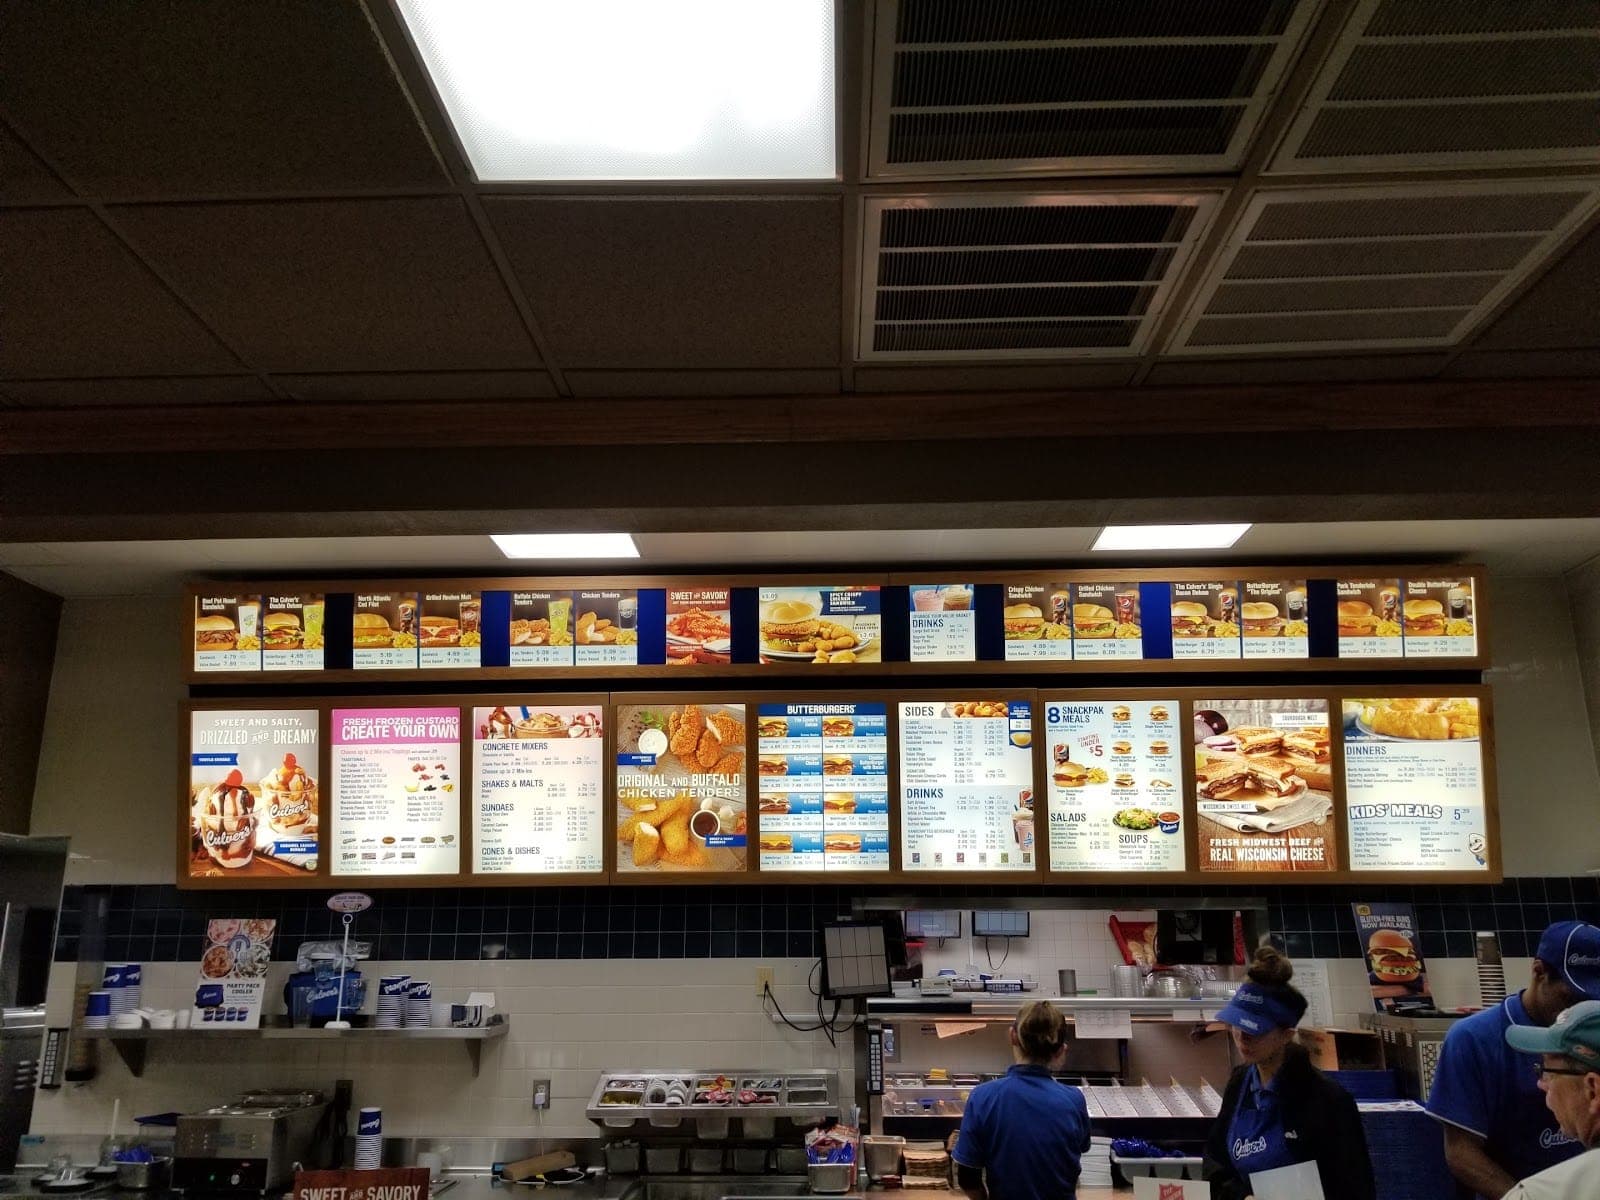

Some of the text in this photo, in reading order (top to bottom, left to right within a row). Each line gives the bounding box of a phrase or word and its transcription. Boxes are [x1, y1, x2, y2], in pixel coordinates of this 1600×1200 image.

[670, 591, 693, 601] SWEET
[701, 591, 728, 600] SAVORY
[912, 618, 944, 628] DRINKS
[787, 705, 856, 714] BUTTERBURGERS
[905, 706, 934, 717] SIDES
[1047, 706, 1104, 723] 8 SNACKPAK
[214, 719, 245, 727] SWEET
[343, 718, 373, 726] FRESH
[415, 717, 458, 725] CUSTARD
[1062, 715, 1090, 723] MEALS
[200, 729, 316, 745] DRIZZLED AND DREAMY
[342, 724, 458, 741] CREATE YOUR OWN
[521, 742, 548, 750] MIXERS
[1080, 739, 1100, 748] UNDER
[1089, 745, 1103, 757] $5
[1346, 746, 1387, 755] DINNERS
[481, 780, 509, 788] SHAKES
[519, 779, 544, 787] MALTS
[618, 774, 740, 787] ORIGINAL AND BUFFALO
[617, 788, 740, 798] CHICKEN TENDERS
[906, 788, 944, 798] DRINKS
[270, 801, 308, 818] Culver's
[481, 803, 514, 812] SUNDAES
[1350, 804, 1389, 820] KIDS'
[1390, 804, 1442, 819] MEALS
[1050, 813, 1086, 822] SALADS
[207, 826, 250, 846] Culver's
[1119, 835, 1148, 844] SOUPS
[1209, 839, 1239, 847] FRESH
[1242, 838, 1287, 846] MIDWEST
[1289, 838, 1312, 846] BEEF
[481, 847, 505, 855] CONES
[1210, 848, 1324, 861] REAL WISCONSIN CHEESE
[1233, 1136, 1267, 1160] Culver's
[300, 1187, 346, 1200] SWEET
[367, 1185, 421, 1200] SAVORY
